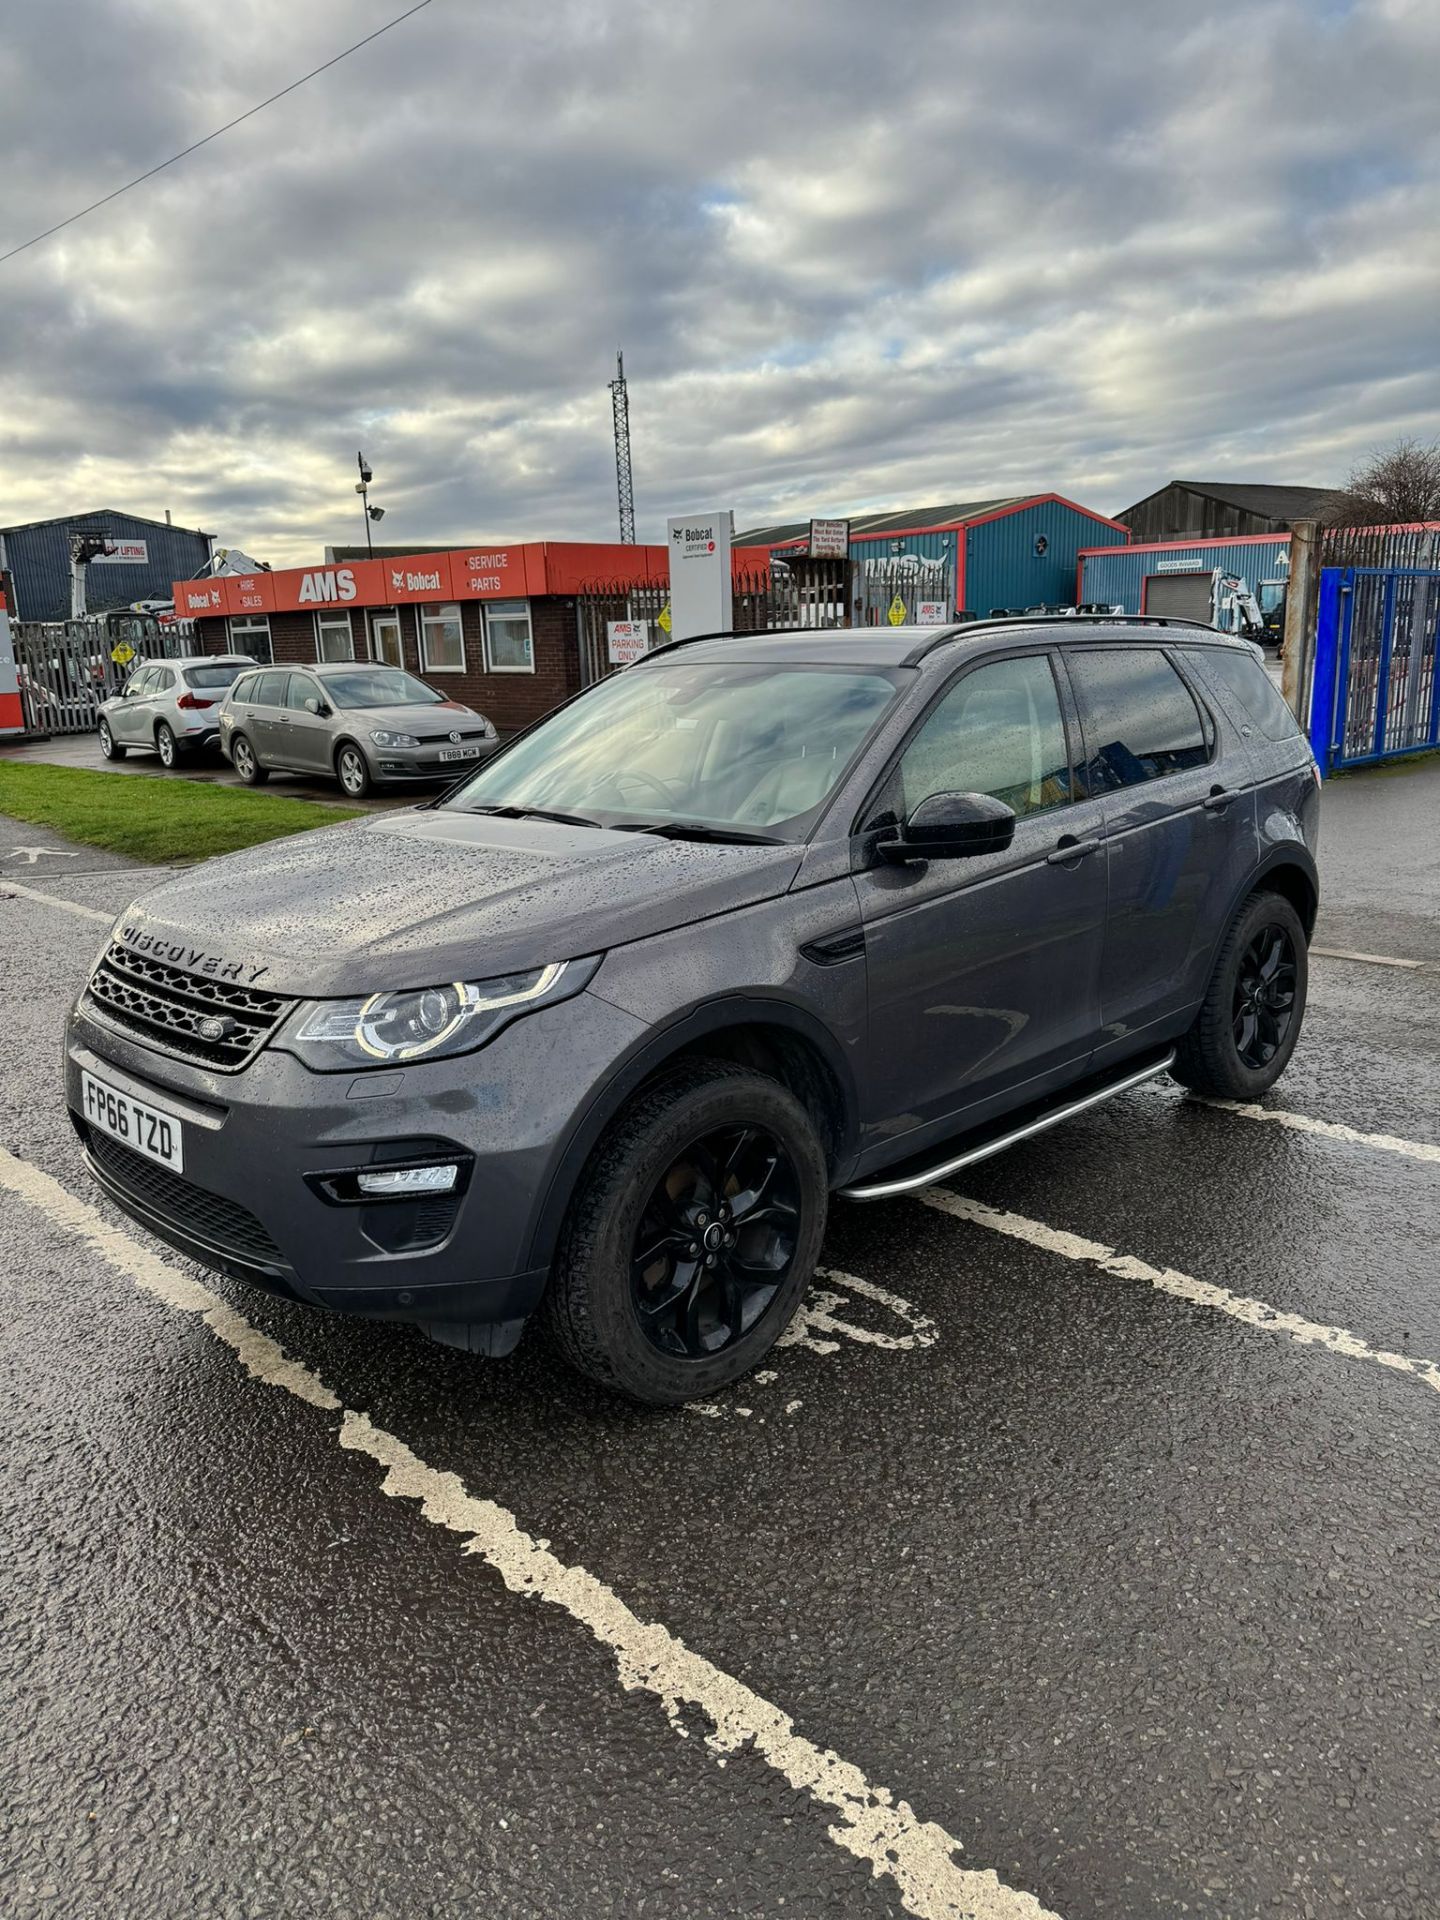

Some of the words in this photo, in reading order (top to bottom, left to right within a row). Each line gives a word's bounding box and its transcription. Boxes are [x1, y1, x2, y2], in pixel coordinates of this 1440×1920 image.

[685, 527, 713, 541] Bobcat
[121, 546, 145, 556] LIFTING
[686, 543, 707, 552] CERTIFIED
[469, 553, 508, 570] SERVICE
[240, 579, 255, 592] HIRE
[298, 569, 356, 603] AMS
[406, 570, 441, 592] Bobcat
[471, 576, 501, 592] PARTS
[188, 592, 210, 609] Bobcat
[242, 595, 263, 608] SALES
[921, 605, 935, 615] AMS
[614, 624, 632, 633] AMS
[612, 639, 644, 649] PARKING
[618, 651, 637, 661] ONLY
[121, 926, 269, 983] DISCOVERY
[87, 1079, 129, 1137] FP66
[133, 1107, 173, 1161] TZD
